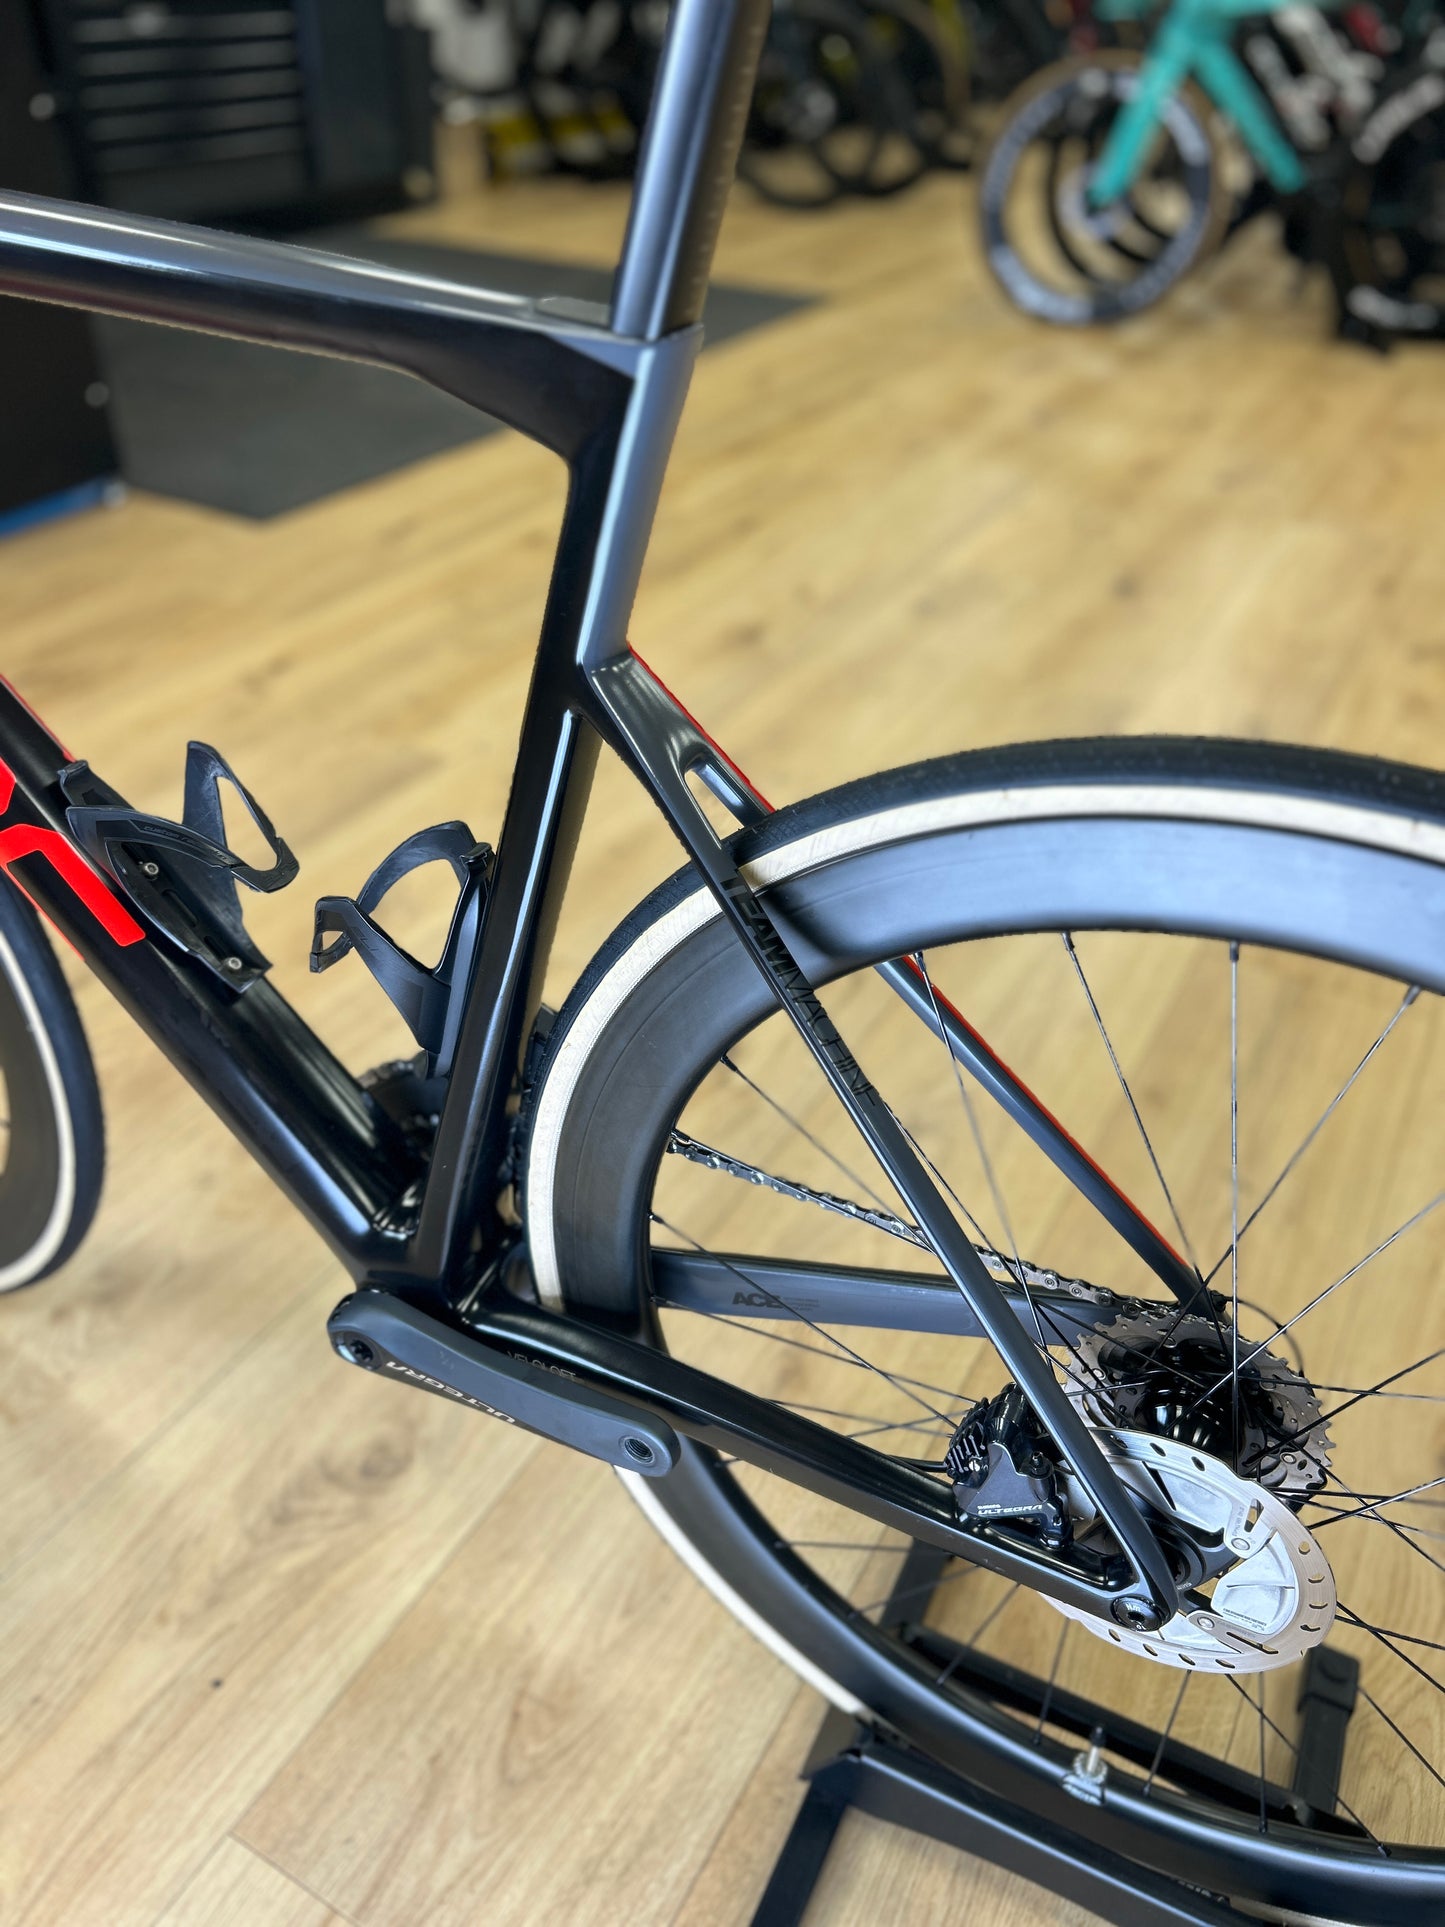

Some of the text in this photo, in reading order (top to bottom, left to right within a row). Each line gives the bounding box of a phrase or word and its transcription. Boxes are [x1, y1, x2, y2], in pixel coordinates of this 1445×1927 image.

[732, 1291, 784, 1309] ACE
[386, 1361, 516, 1424] ULTEGRA
[977, 1504, 1043, 1515] ULTEGRA
